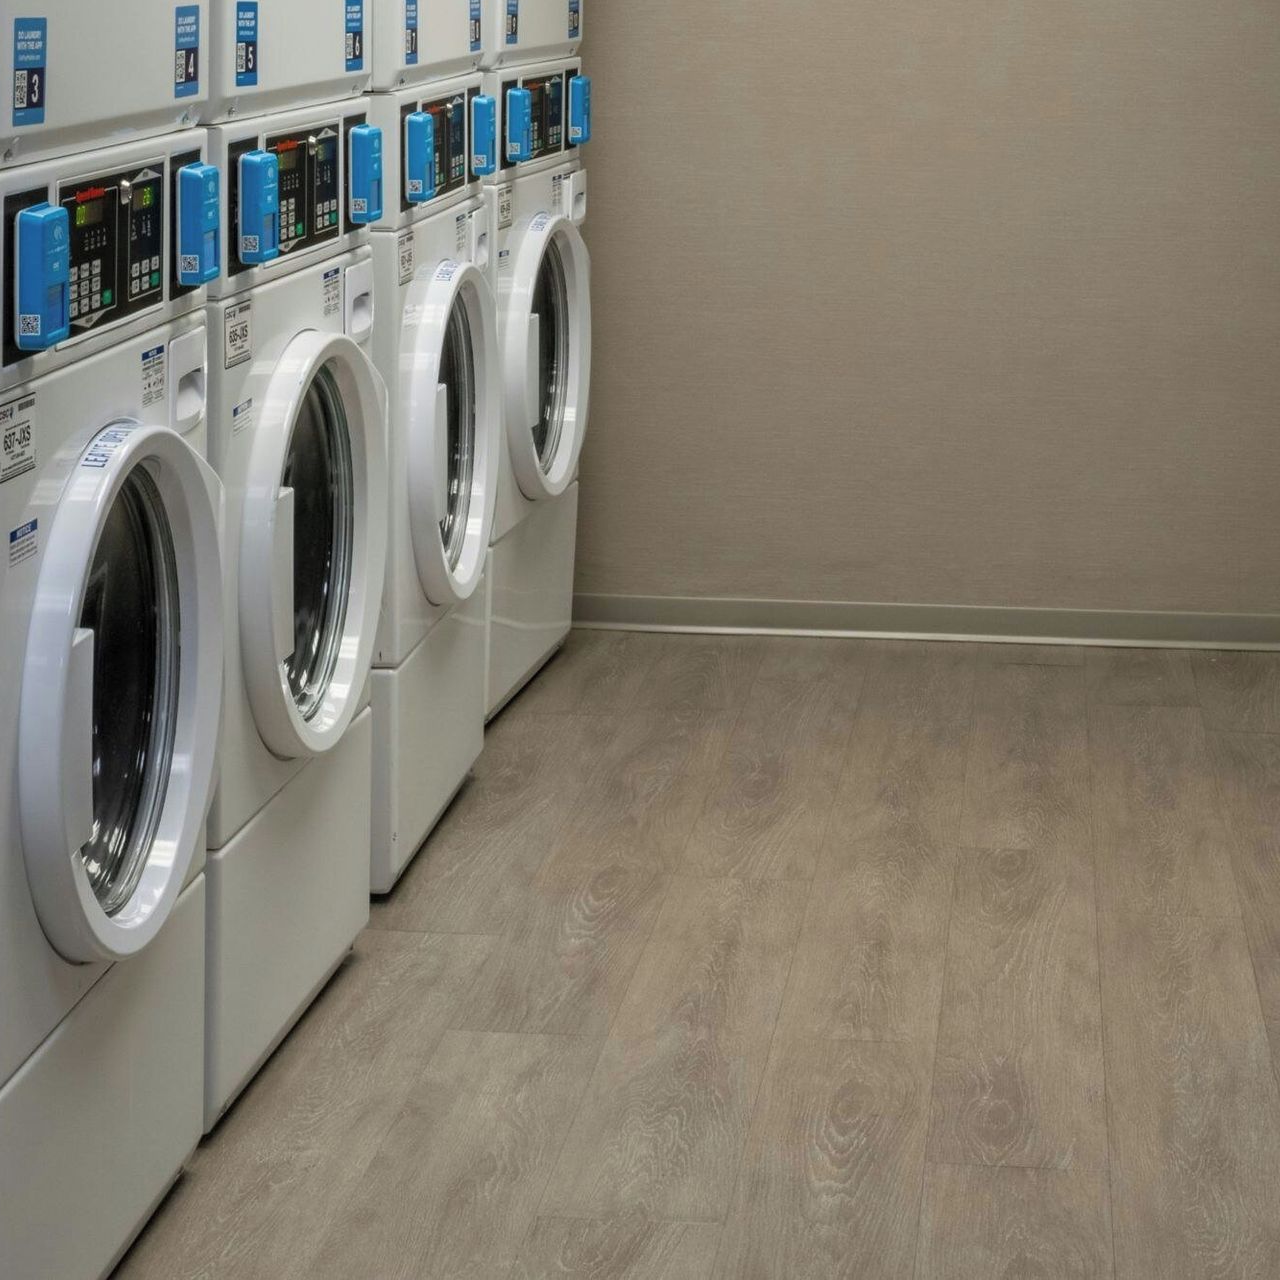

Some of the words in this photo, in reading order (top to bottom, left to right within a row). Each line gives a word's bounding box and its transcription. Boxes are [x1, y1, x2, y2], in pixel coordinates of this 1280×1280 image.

[248, 46, 253, 70] 5
[355, 35, 360, 56] 6
[188, 52, 195, 77] 4
[31, 73, 40, 103] 3
[4, 424, 31, 451] 637-JXS
